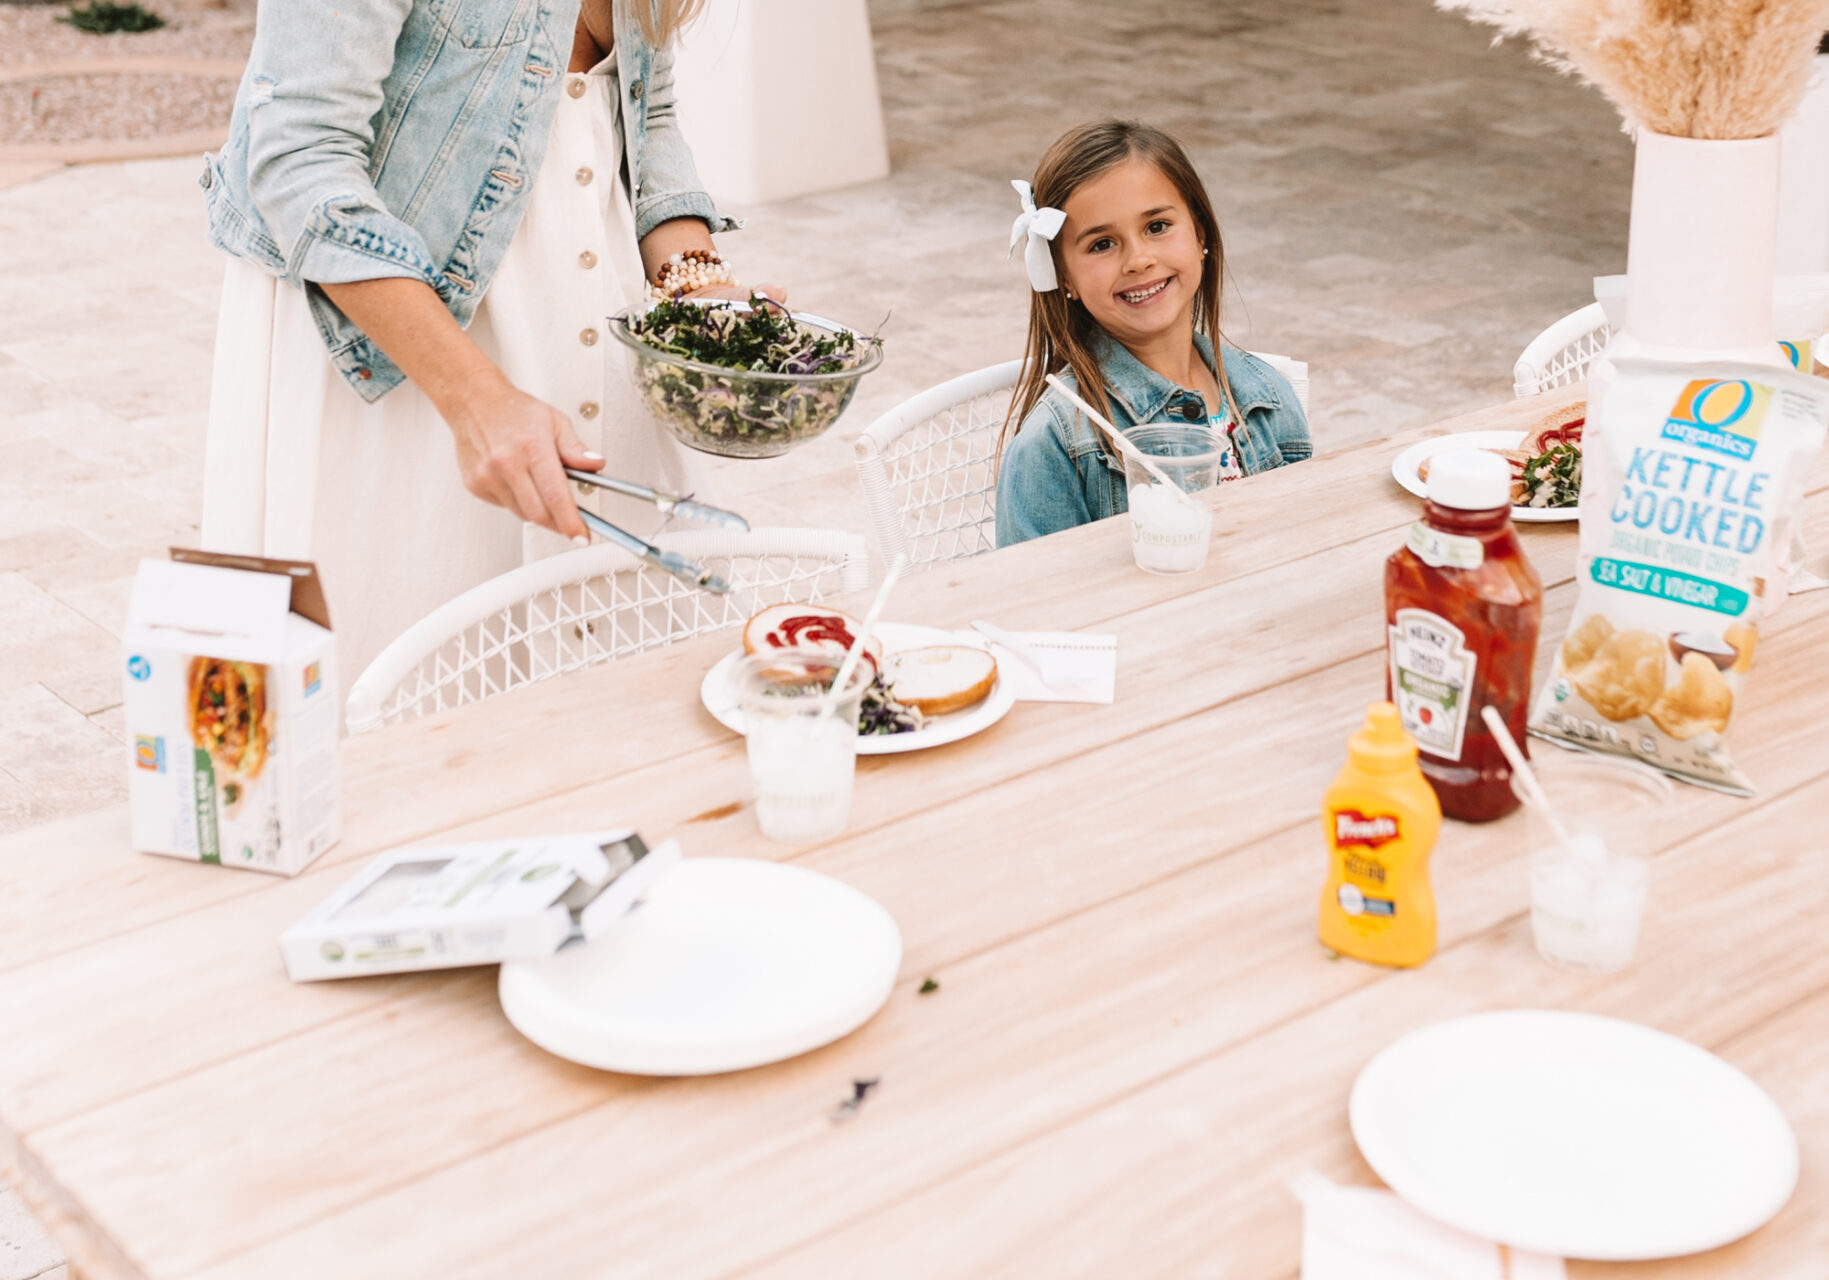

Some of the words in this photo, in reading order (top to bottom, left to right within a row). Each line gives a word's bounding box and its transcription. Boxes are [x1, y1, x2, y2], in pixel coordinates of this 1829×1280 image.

[1665, 422, 1752, 456] organics
[1626, 447, 1770, 510] KETTLE
[1610, 484, 1764, 554] COOKED
[1619, 564, 1652, 591] SALT
[1650, 572, 1662, 594] &
[1664, 575, 1719, 607] VINEGAR
